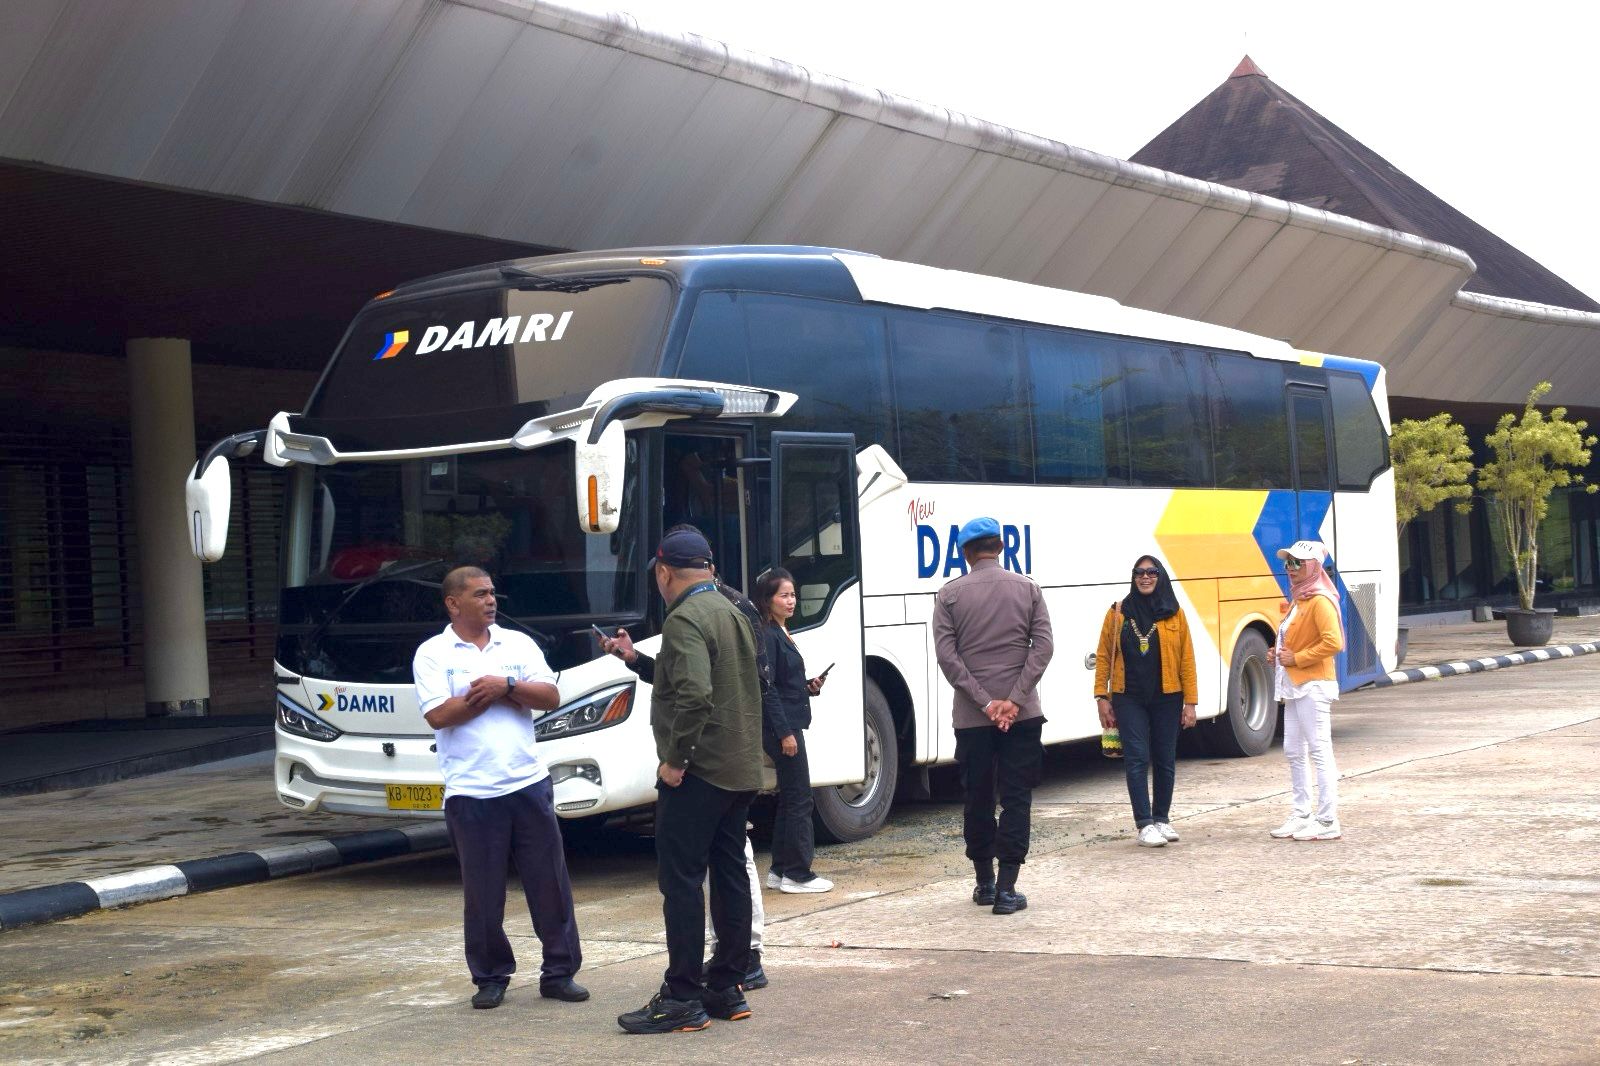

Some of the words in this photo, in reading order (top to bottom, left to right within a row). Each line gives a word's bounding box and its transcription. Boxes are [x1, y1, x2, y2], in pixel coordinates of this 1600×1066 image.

[415, 311, 574, 355] DAMRI
[908, 497, 935, 531] New
[917, 524, 1032, 579] DARI
[337, 694, 395, 713] DAMRI
[388, 786, 402, 801] KB
[407, 786, 432, 801] 7023
